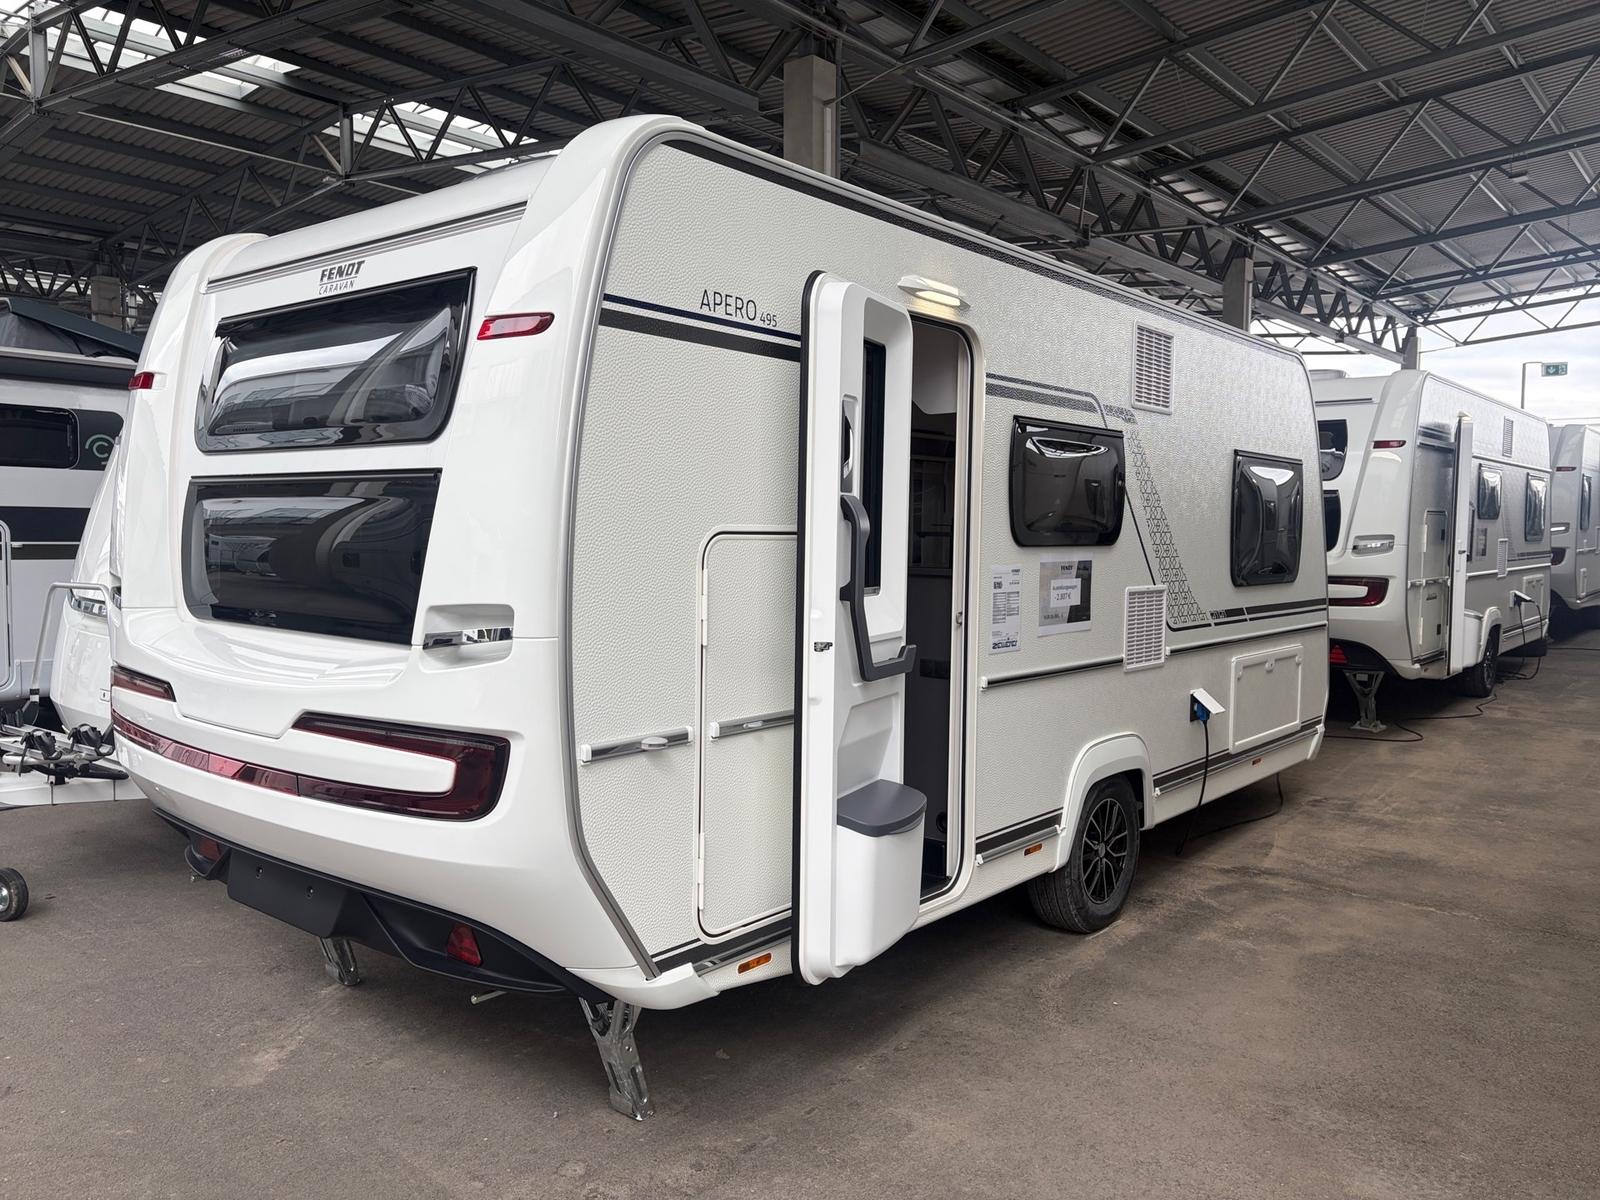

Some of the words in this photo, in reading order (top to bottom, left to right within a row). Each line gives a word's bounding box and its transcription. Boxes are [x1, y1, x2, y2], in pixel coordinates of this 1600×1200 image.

[320, 260, 366, 282] FENDT
[319, 280, 355, 295] CARAVAN
[700, 289, 757, 321] APERO
[760, 312, 778, 328] 495
